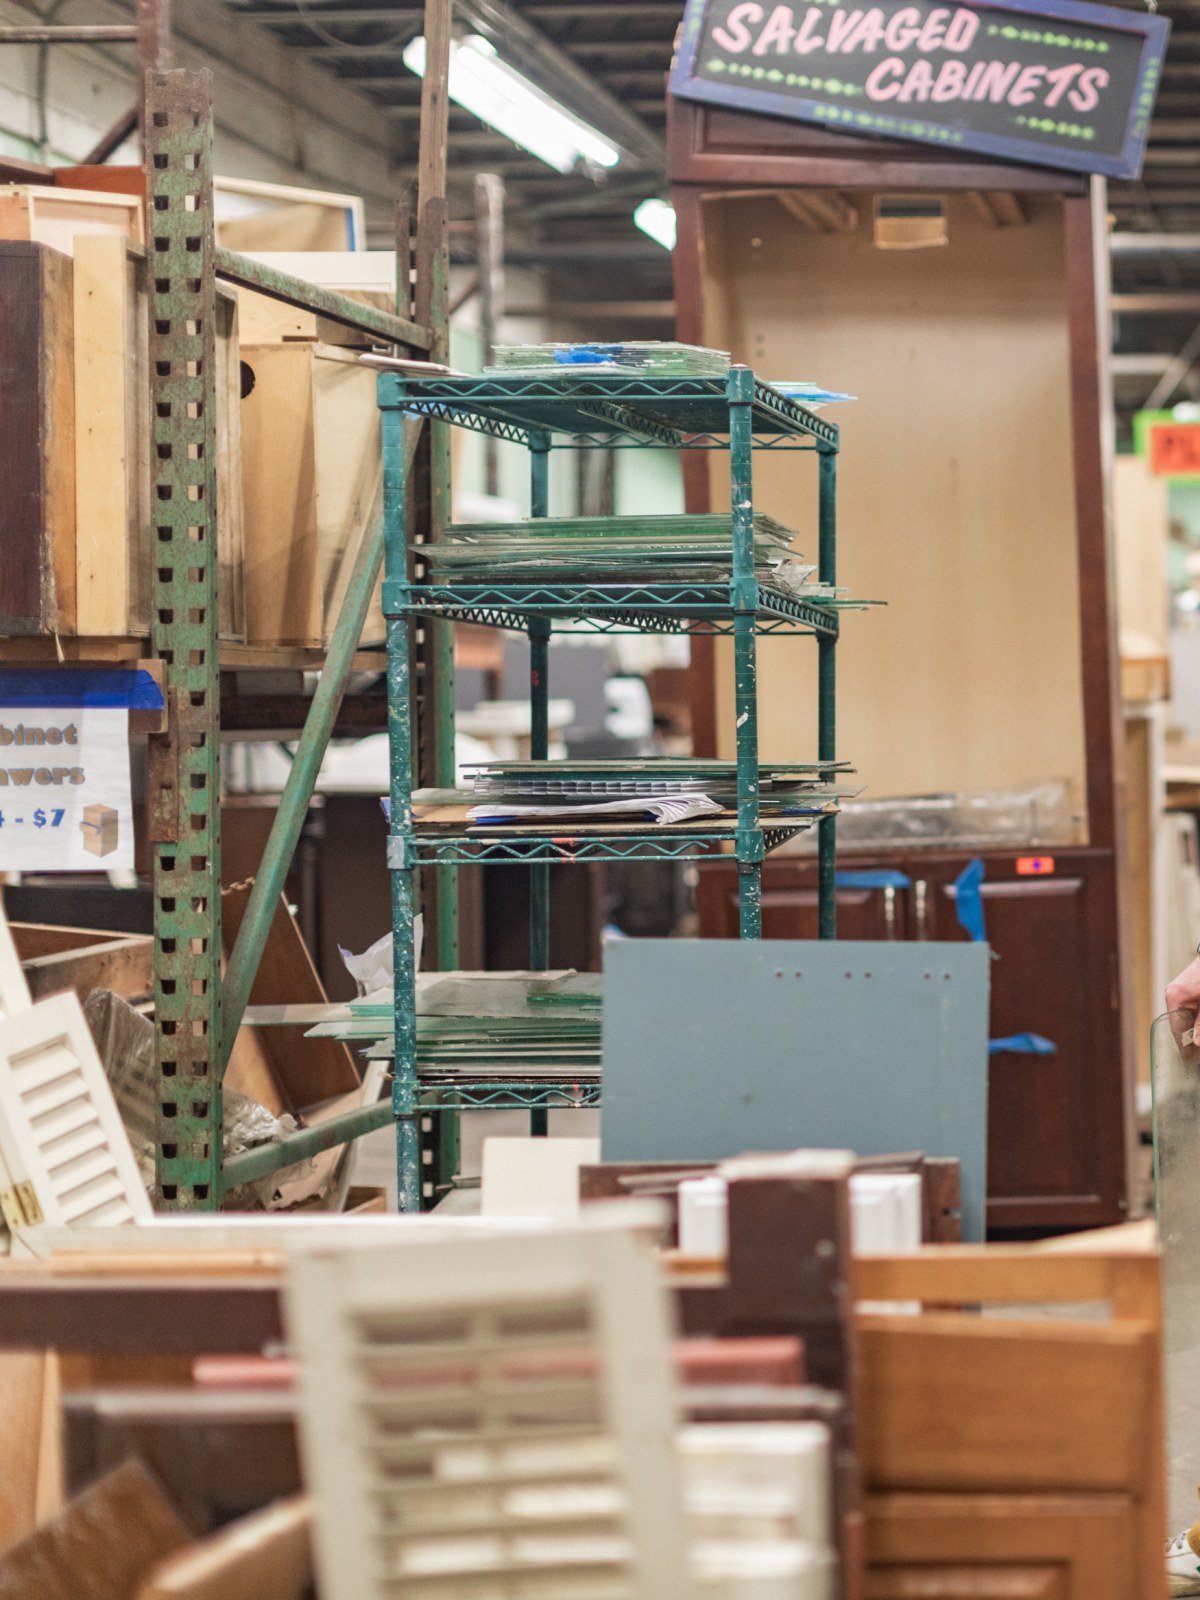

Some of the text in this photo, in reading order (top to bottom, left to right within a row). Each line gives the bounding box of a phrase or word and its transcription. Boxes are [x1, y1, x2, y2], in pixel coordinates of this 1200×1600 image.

[711, 2, 980, 56] SALVAGED
[865, 56, 1110, 112] CABINETS
[33, 808, 66, 829] $7
